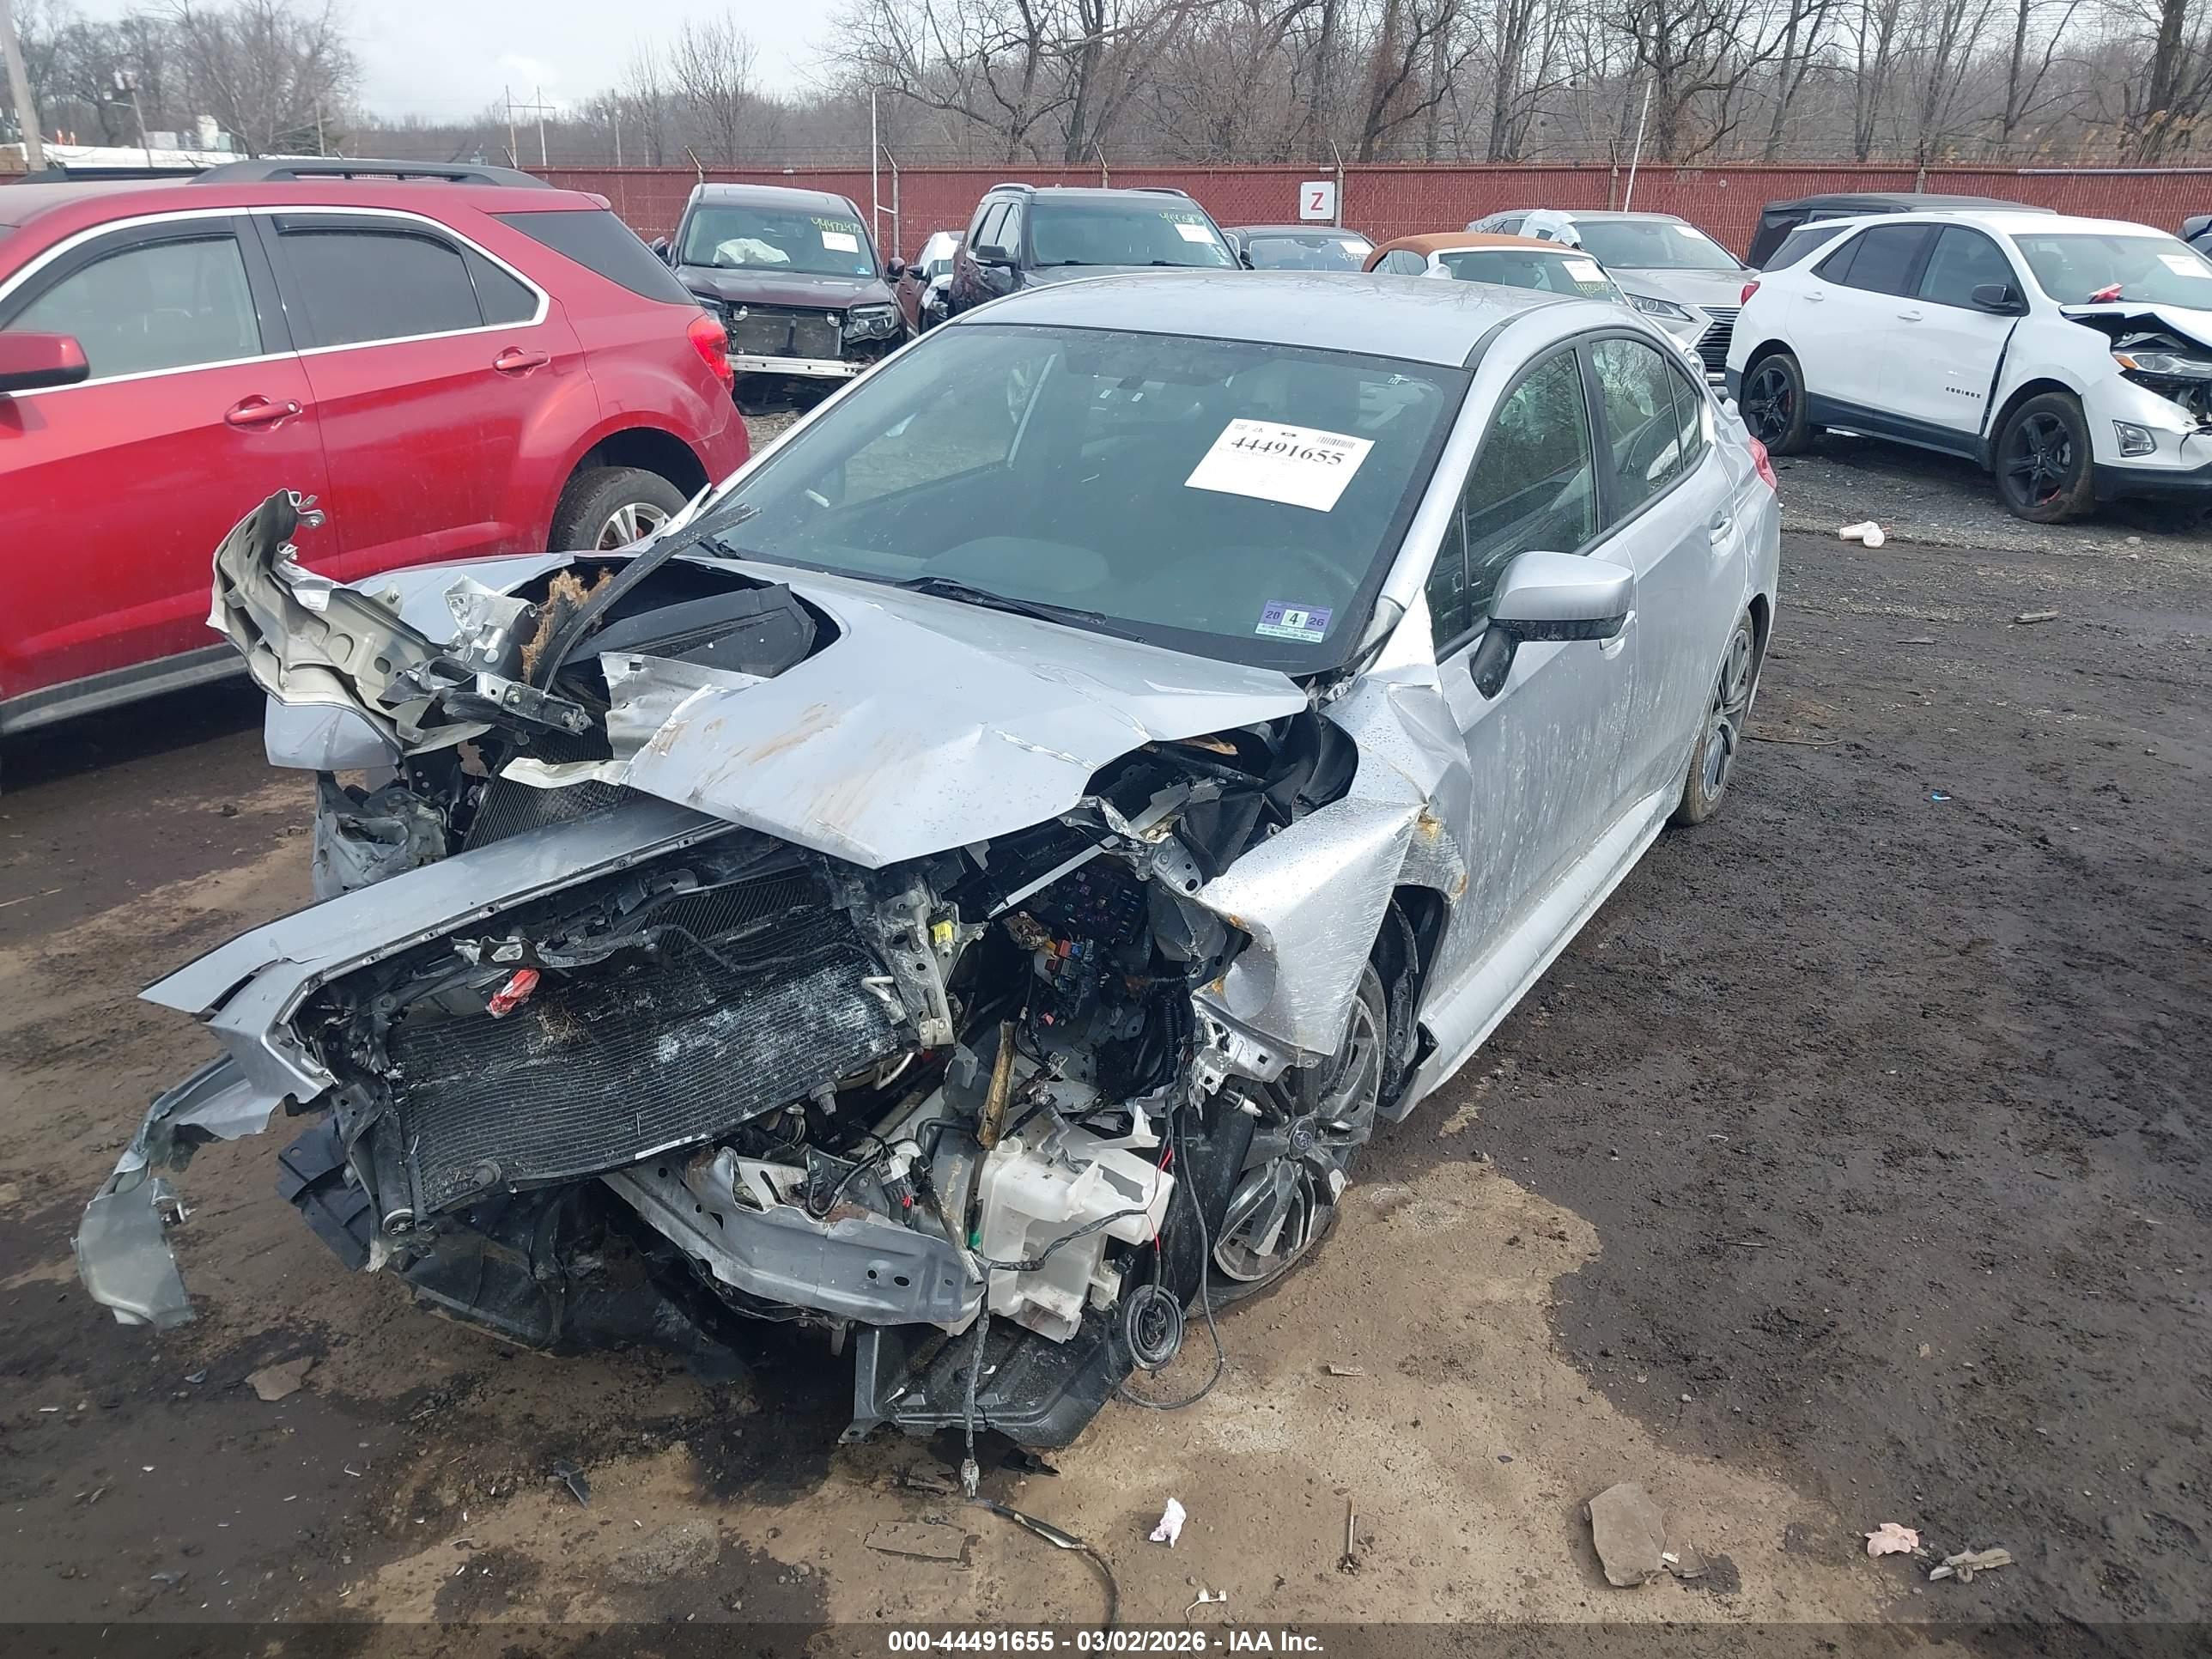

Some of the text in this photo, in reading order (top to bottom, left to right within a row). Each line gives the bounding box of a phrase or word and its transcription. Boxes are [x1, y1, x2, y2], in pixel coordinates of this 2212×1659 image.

[1310, 191, 1324, 210] Z
[1231, 436, 1346, 465] 44491655
[1265, 611, 1325, 627] 20 4 26
